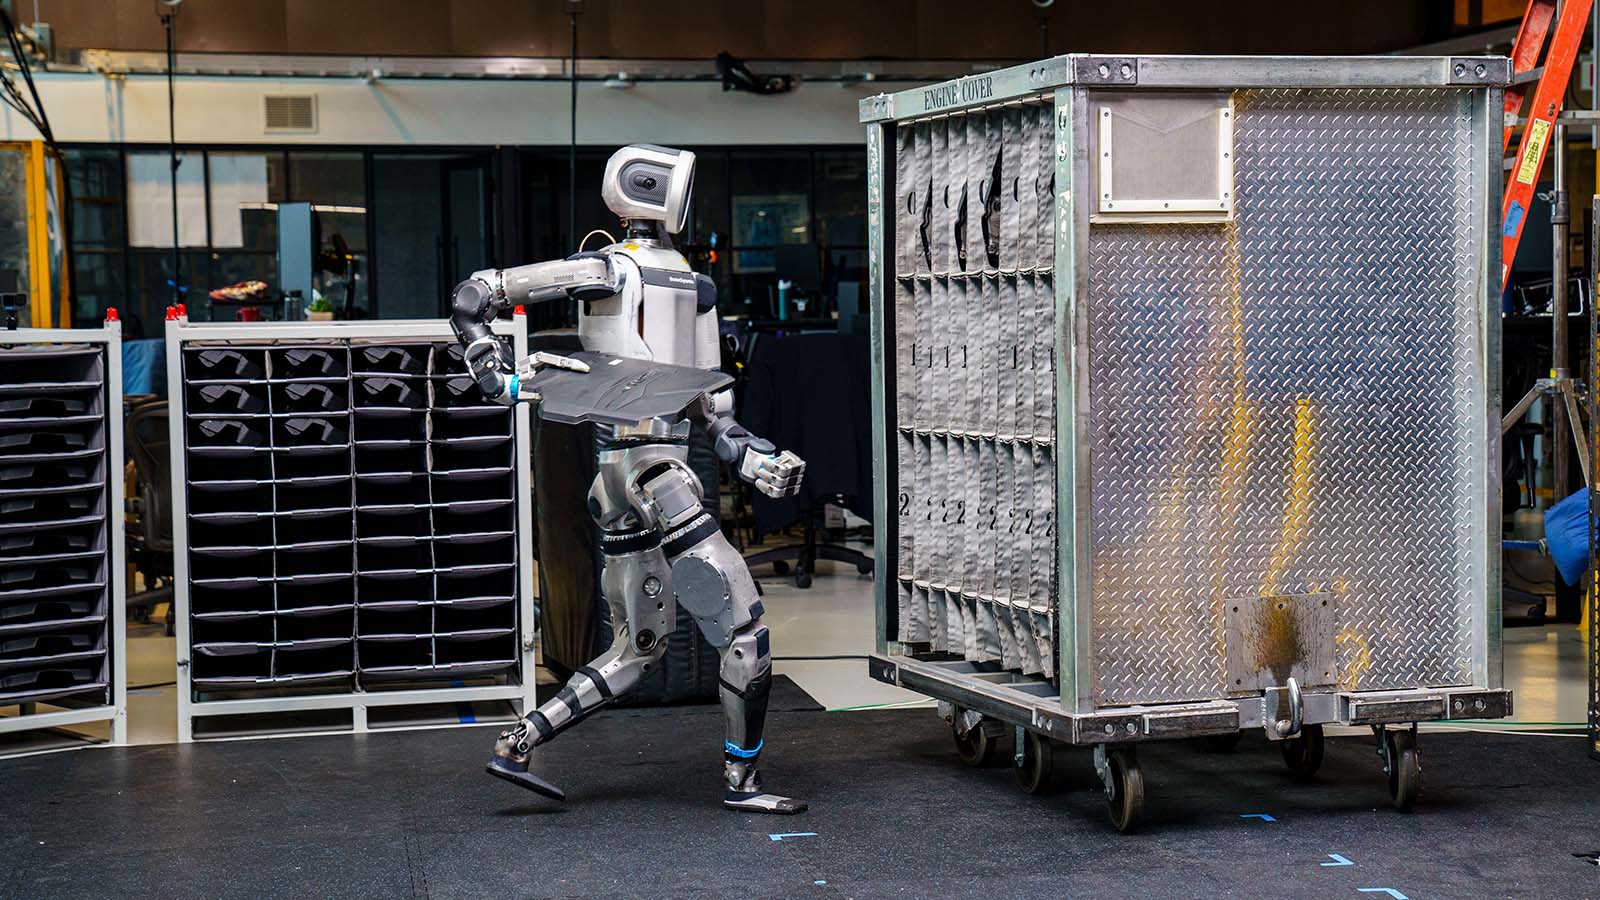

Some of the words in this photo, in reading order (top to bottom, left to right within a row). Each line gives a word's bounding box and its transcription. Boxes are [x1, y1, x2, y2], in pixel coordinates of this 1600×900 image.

[924, 84, 958, 110] ENGINE
[962, 76, 993, 102] COVER
[899, 492, 910, 516] 2
